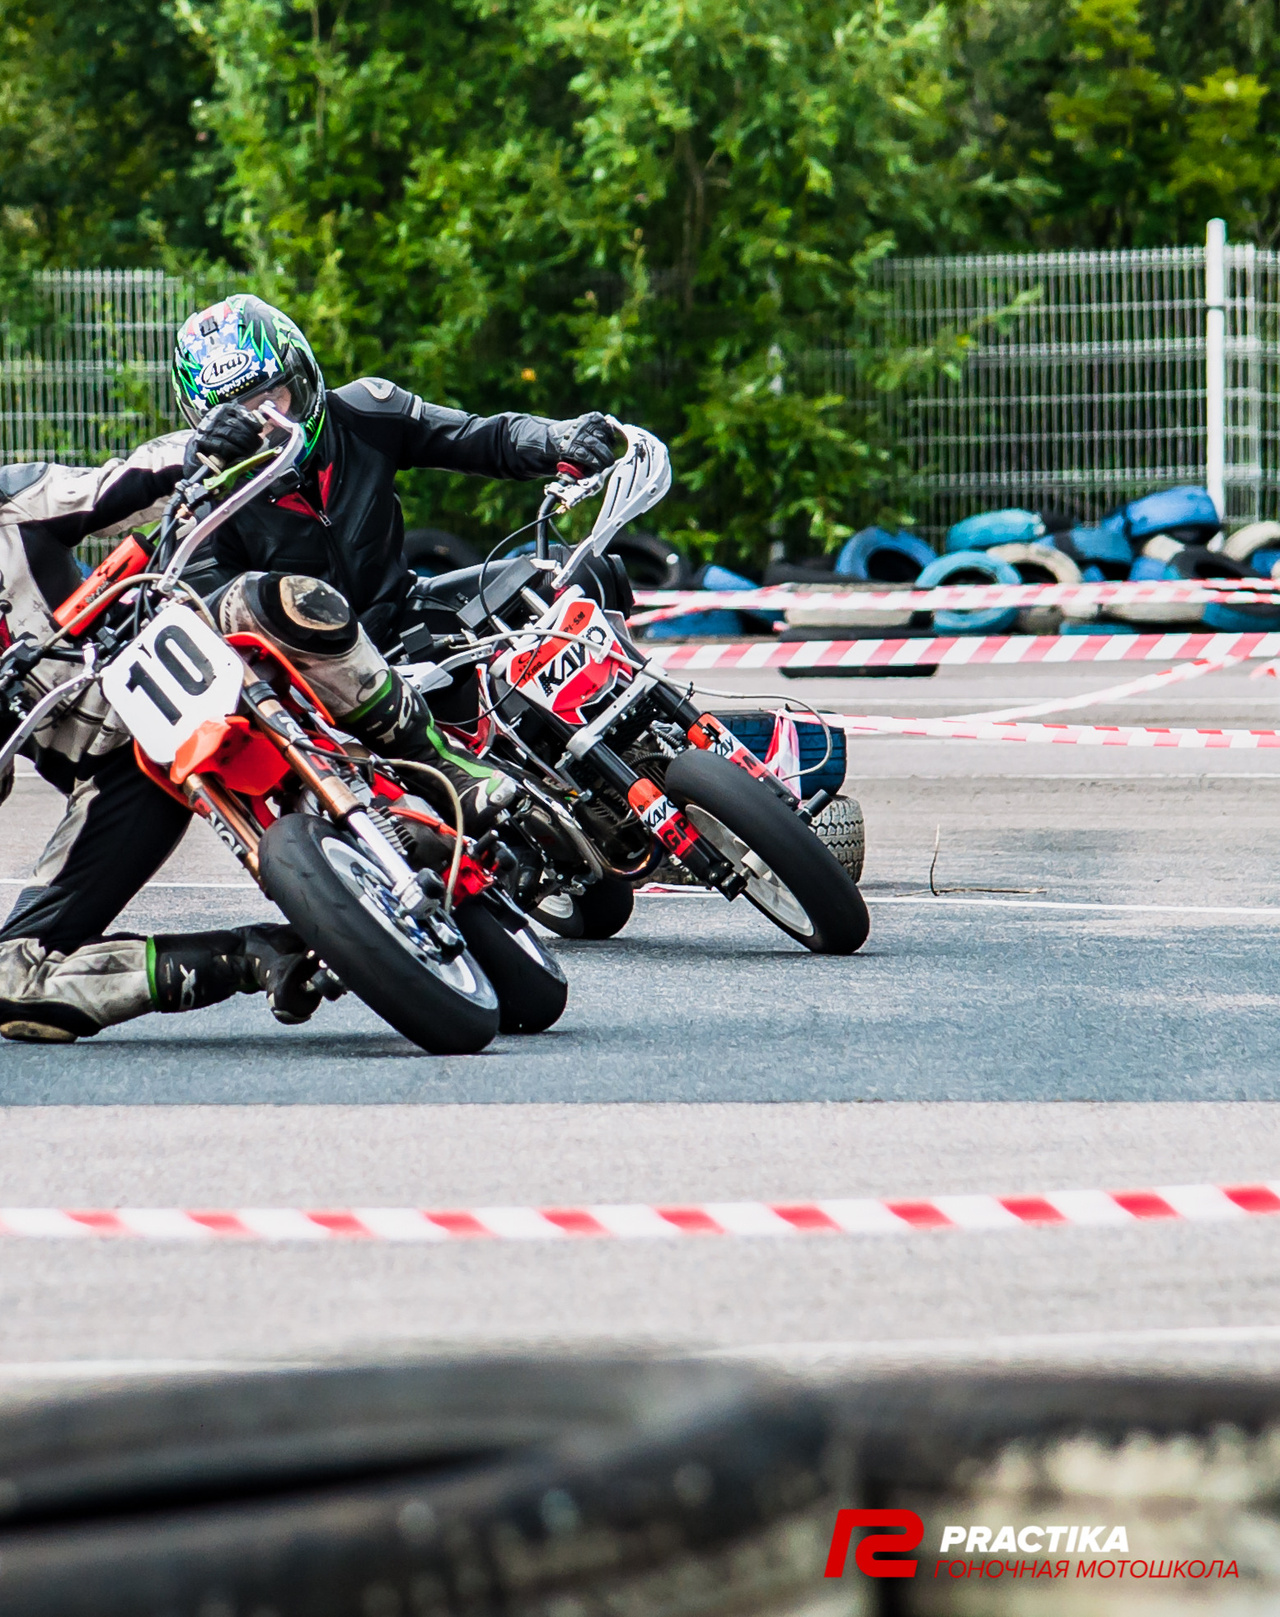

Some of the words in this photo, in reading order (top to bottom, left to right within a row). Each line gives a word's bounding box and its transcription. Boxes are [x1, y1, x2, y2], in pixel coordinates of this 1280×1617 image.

[206, 353, 242, 383] Arai
[125, 625, 217, 726] 10
[663, 818, 689, 851] GP
